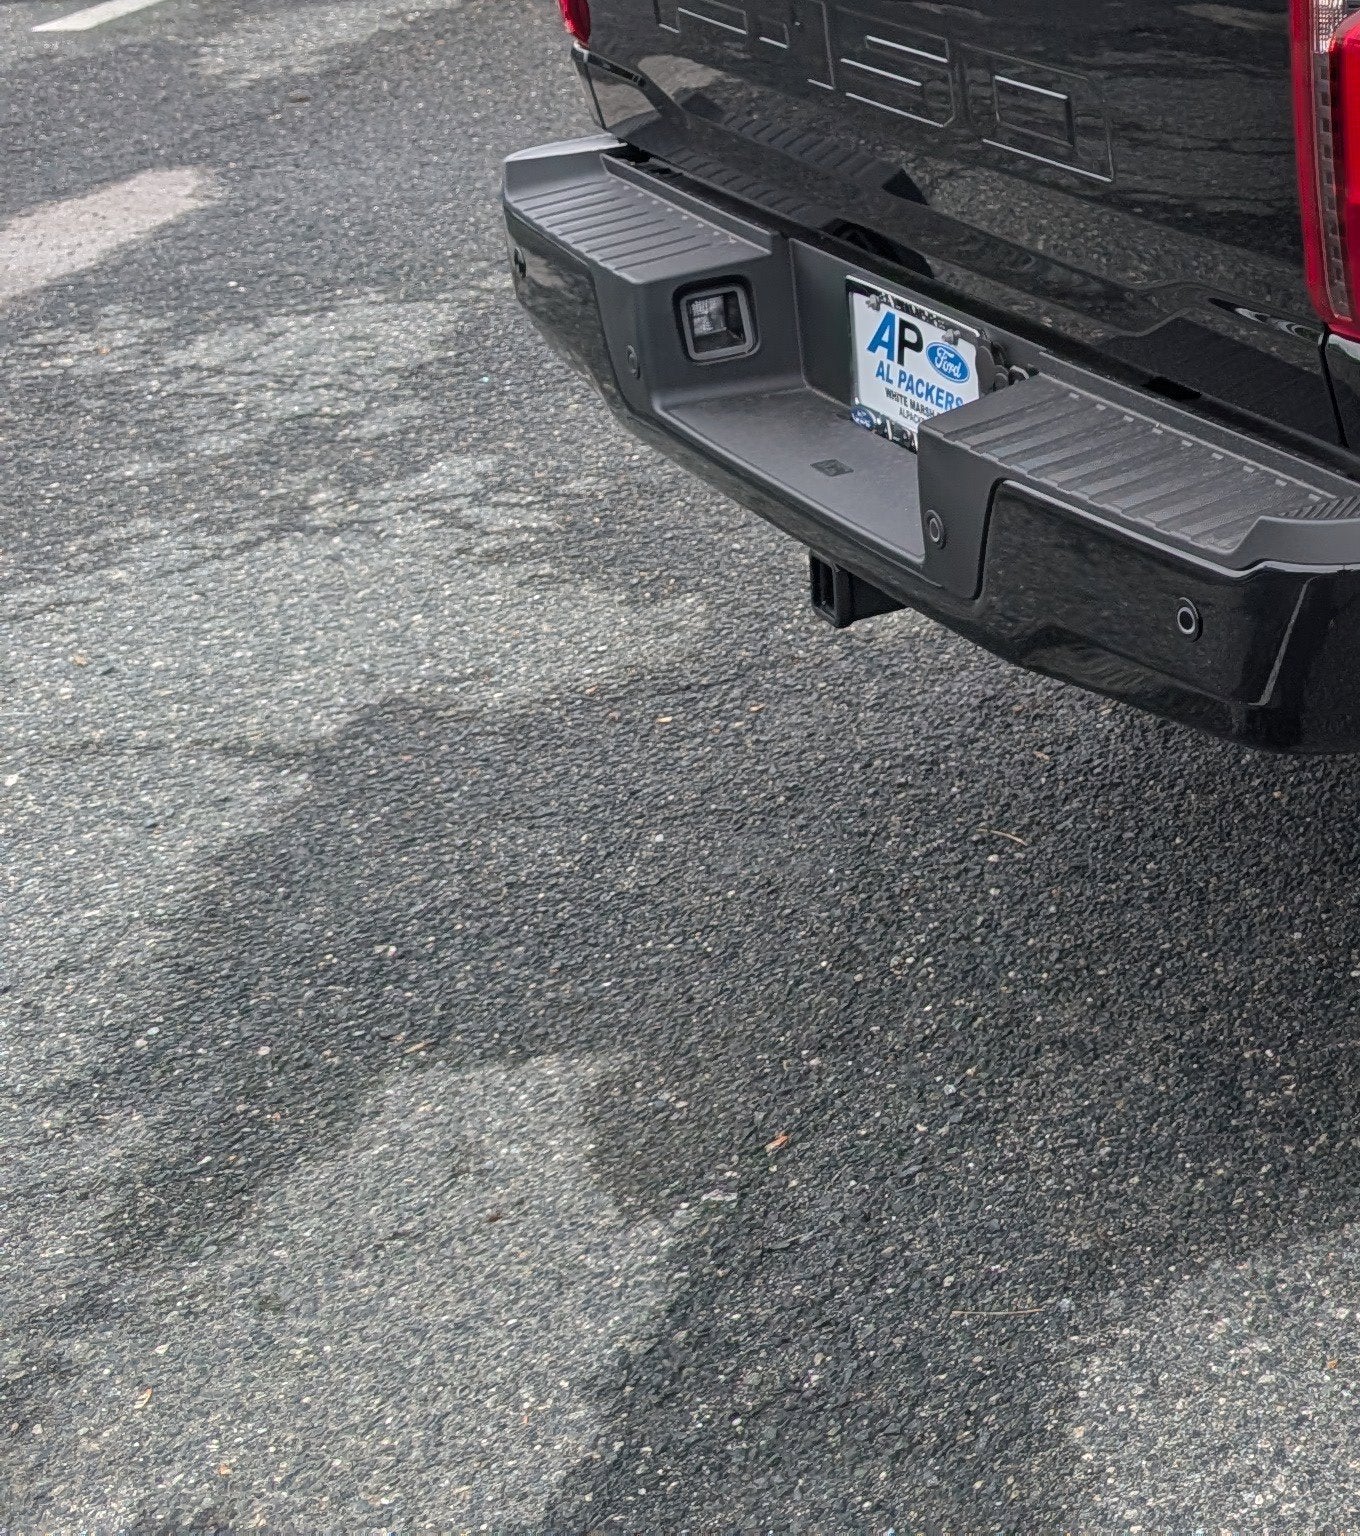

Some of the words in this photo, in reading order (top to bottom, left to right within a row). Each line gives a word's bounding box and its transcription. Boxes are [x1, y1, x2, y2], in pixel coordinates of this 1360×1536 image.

[866, 310, 924, 367] AP
[933, 345, 963, 381] Ford
[875, 359, 895, 385] AL
